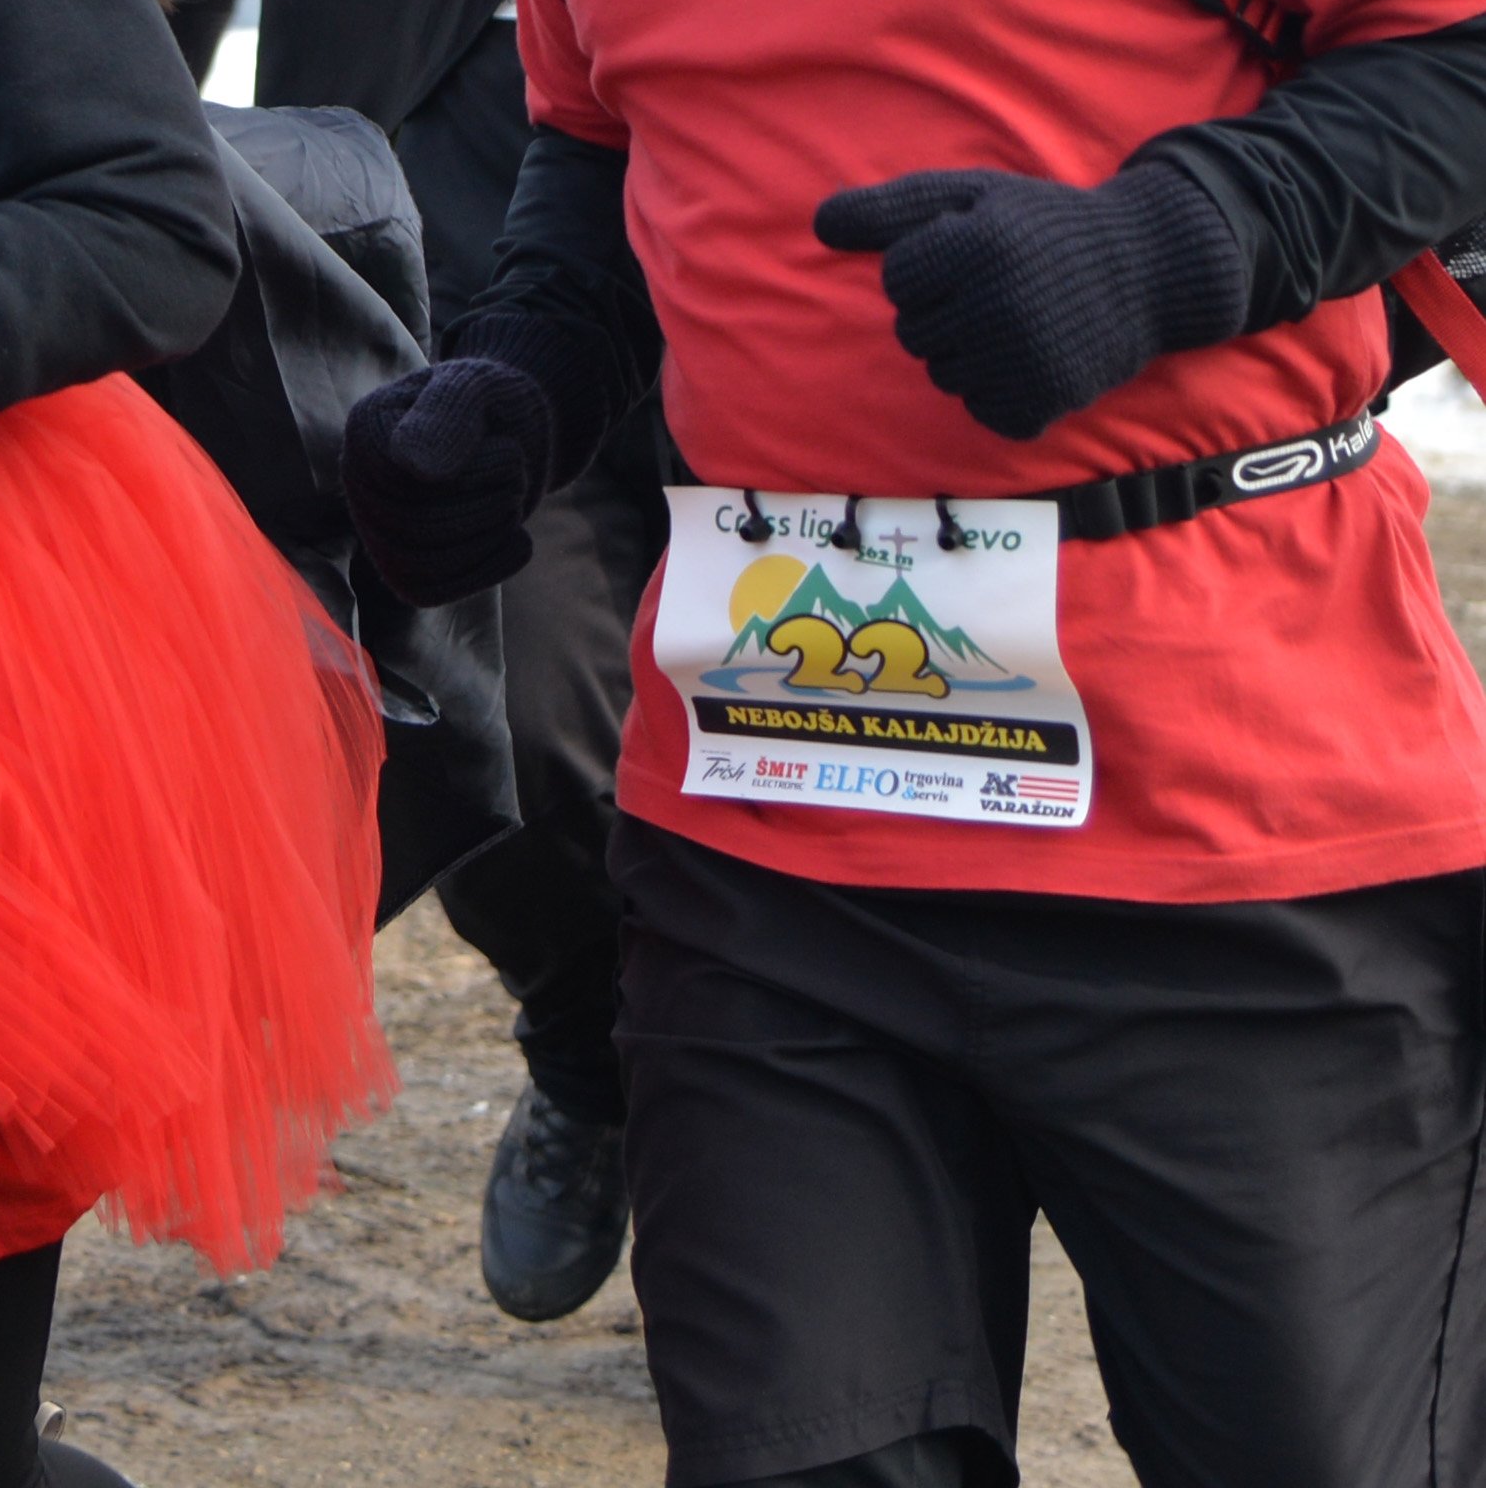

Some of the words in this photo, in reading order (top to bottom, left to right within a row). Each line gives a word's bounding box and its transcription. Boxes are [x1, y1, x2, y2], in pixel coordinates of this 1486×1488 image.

[715, 505, 791, 536] Crss
[799, 509, 836, 548] lig
[954, 515, 1021, 551] evo
[766, 614, 950, 699] 22
[726, 706, 856, 735] NEBOJŠA
[861, 716, 1047, 752] KALAJDŽIJA
[755, 756, 808, 780] ŠMIT
[814, 762, 900, 797] ELFO
[904, 770, 964, 789] trgovina
[980, 799, 1076, 818] VARAŽDIN
